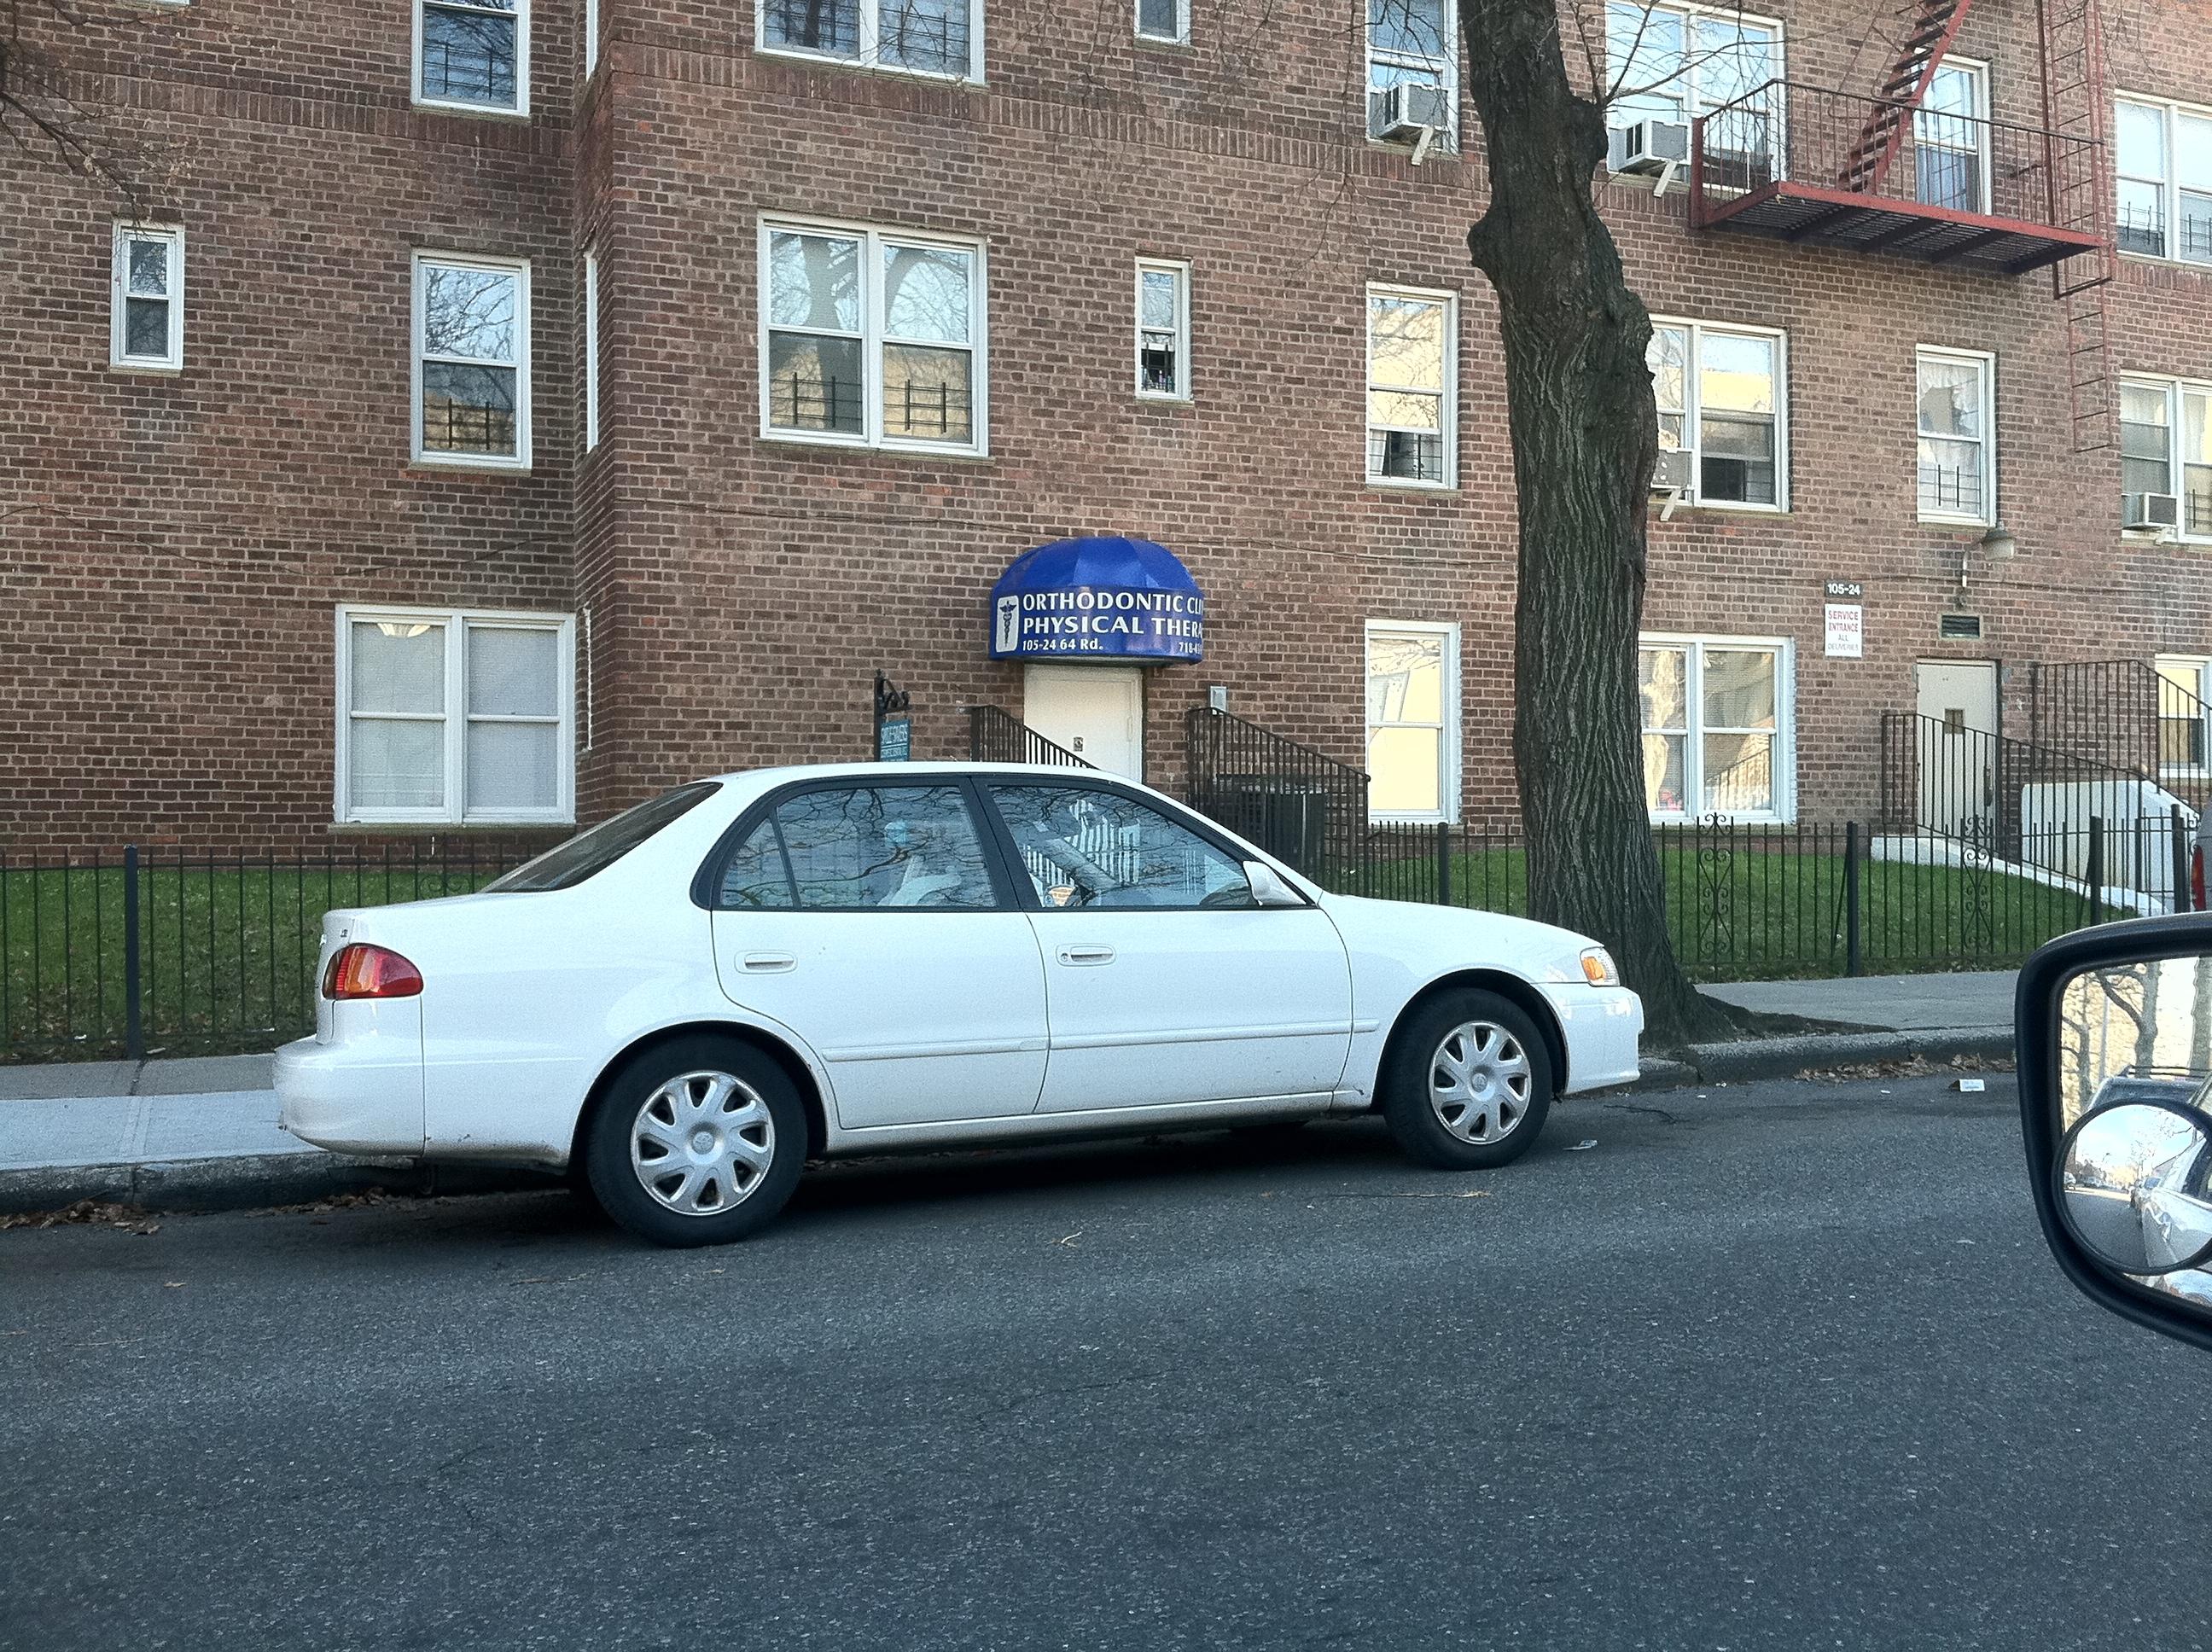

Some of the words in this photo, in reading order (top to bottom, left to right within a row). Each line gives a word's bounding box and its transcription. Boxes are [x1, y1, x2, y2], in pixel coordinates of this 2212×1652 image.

[1827, 583, 1860, 595] 105-24
[1023, 592, 1183, 612] ORTHODONTIC
[1828, 610, 1859, 620] SERVICE
[1023, 616, 1144, 634] PHYSICAL
[1828, 622, 1859, 632] ENTRANCE
[1022, 639, 1056, 651] 105-24
[1060, 638, 1075, 649] 64
[1080, 637, 1103, 650] Rd.
